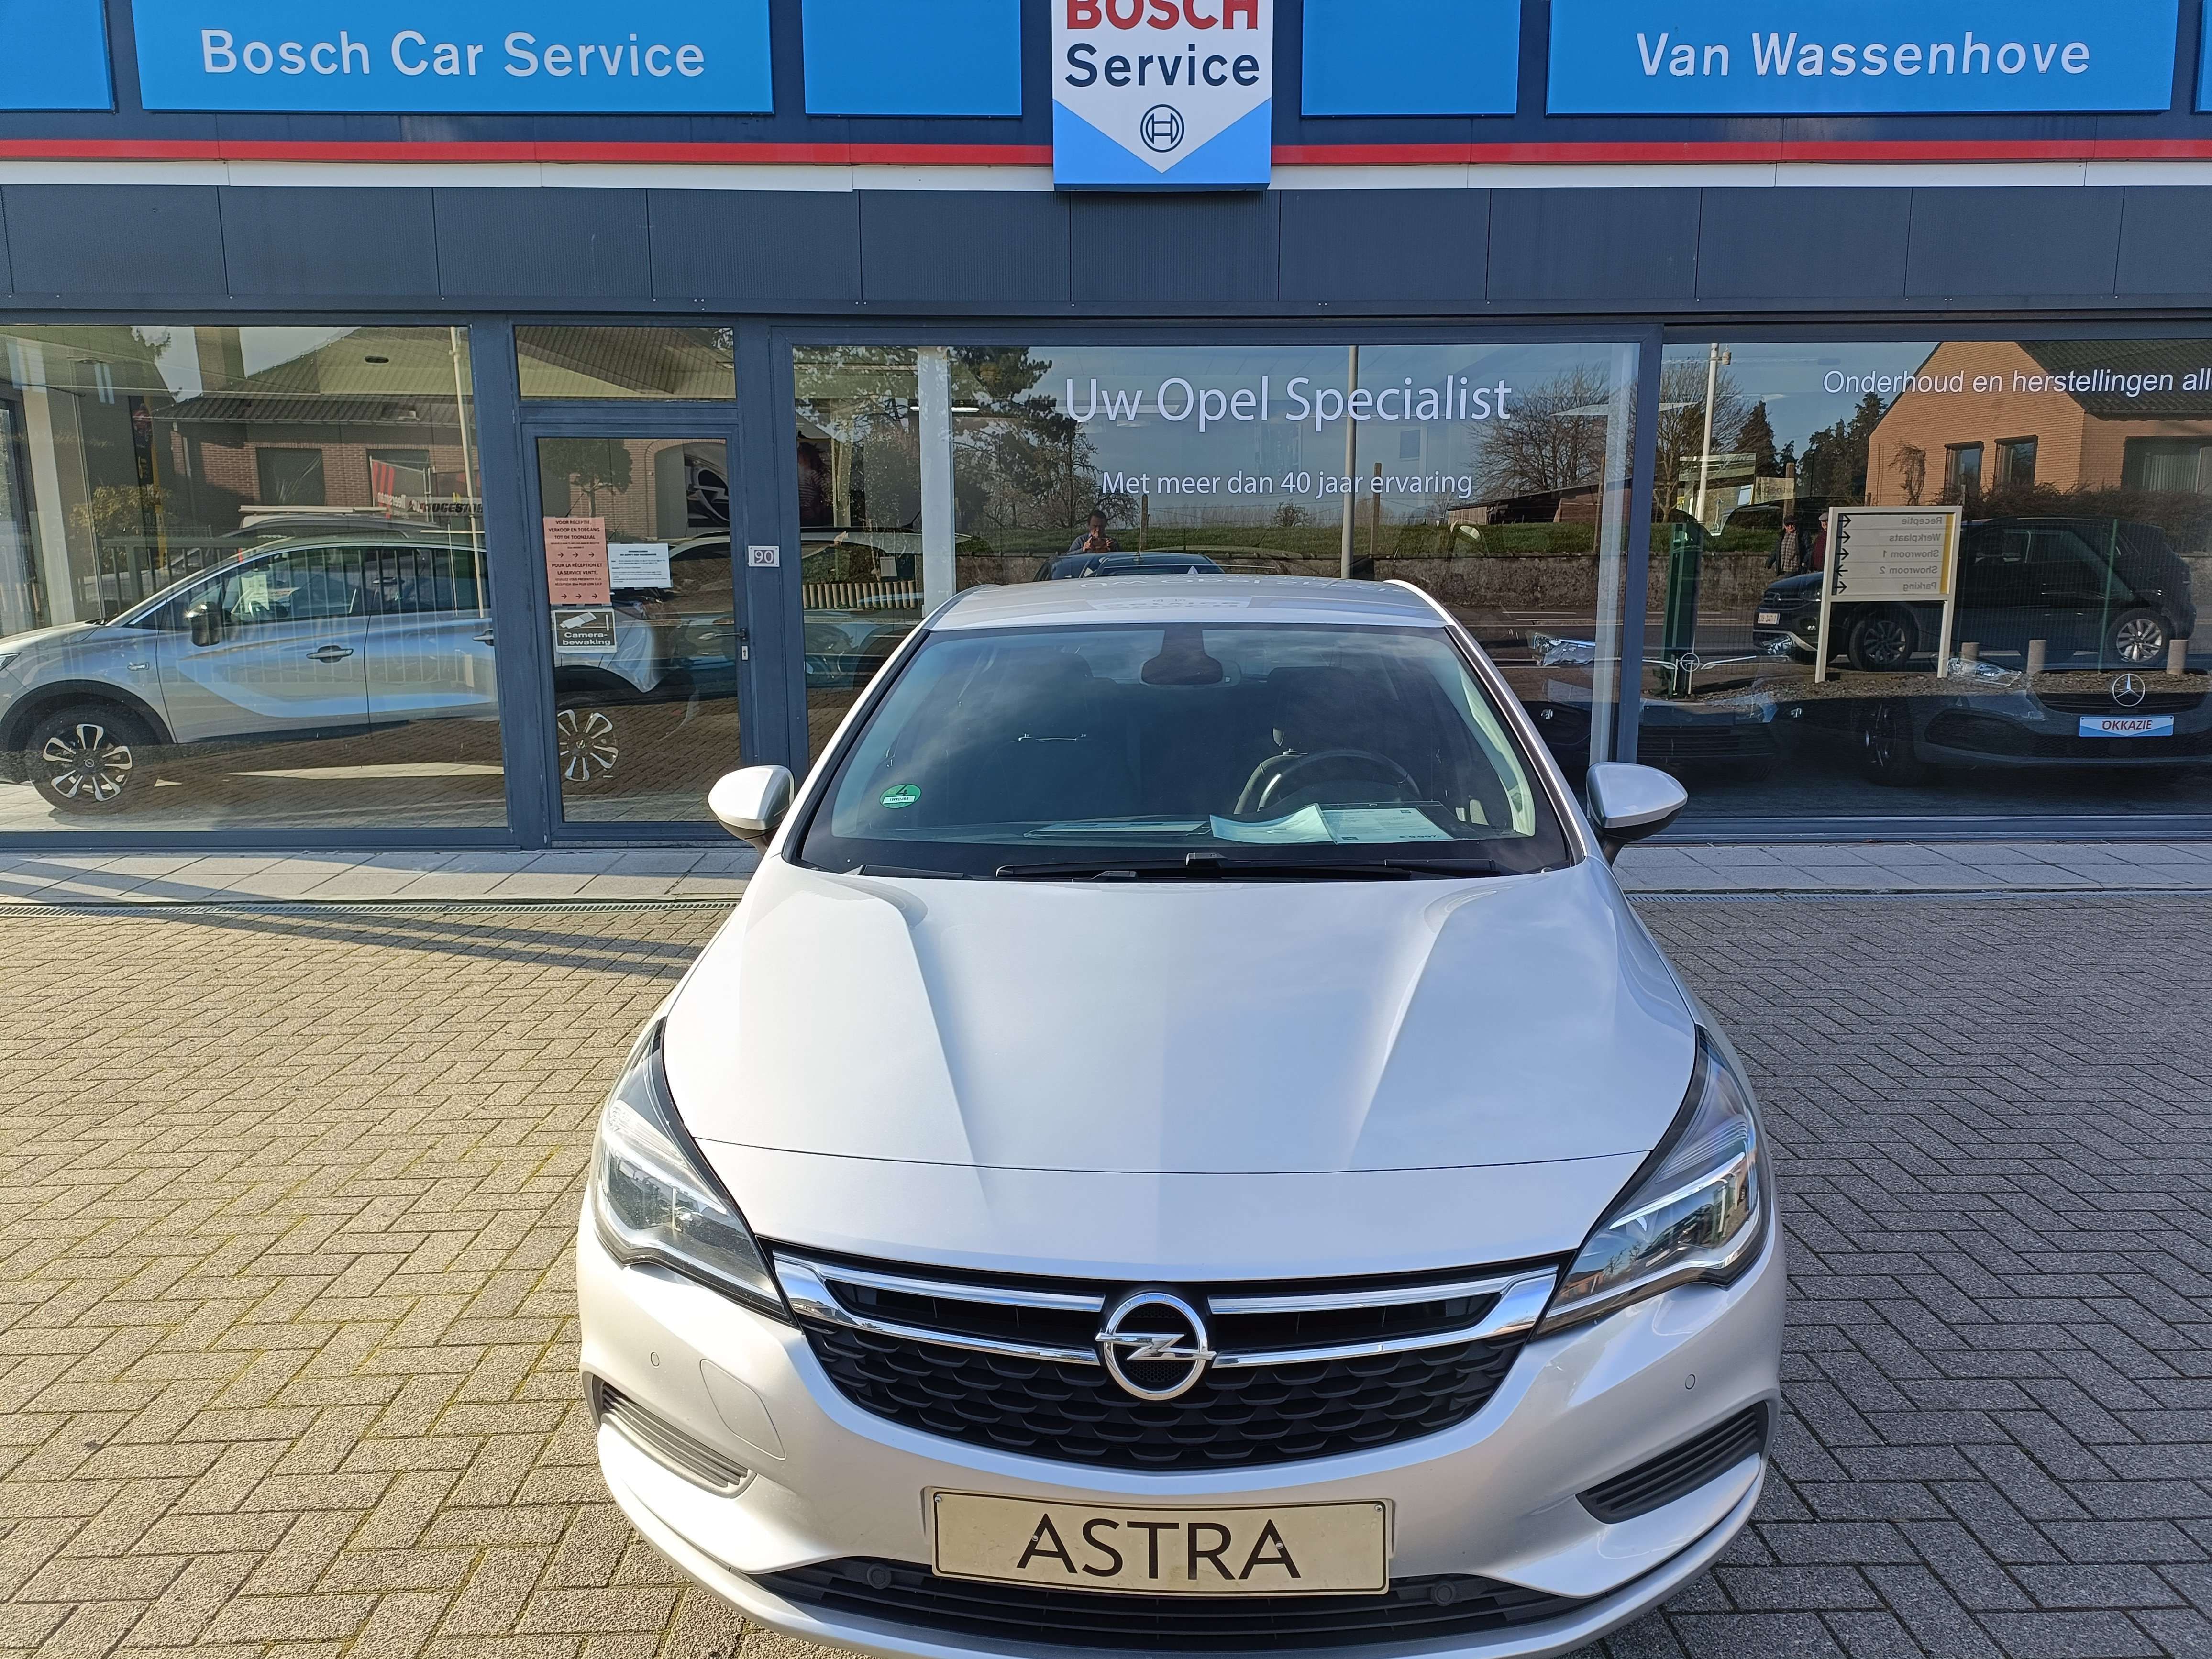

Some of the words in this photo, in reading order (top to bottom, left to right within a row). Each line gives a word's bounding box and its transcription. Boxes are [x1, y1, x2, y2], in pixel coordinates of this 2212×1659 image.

[1067, 0, 1258, 30] BOSCH
[201, 29, 371, 76] Bosch
[390, 30, 484, 77] Car
[503, 32, 705, 78] Service
[1065, 43, 1260, 88] Service
[1636, 33, 1730, 77] Van
[1750, 31, 2090, 77] Wassenhove
[1822, 369, 1964, 394] Onderhoud
[1971, 374, 2003, 393] en
[2011, 368, 2174, 398] herstellingen
[2182, 368, 2212, 391] all
[1065, 377, 1143, 422] Uw
[1157, 376, 1269, 432] Opel
[1285, 375, 1512, 432] Specialist
[1102, 471, 1150, 496] Met
[1157, 476, 1222, 495] meer
[1226, 471, 1273, 495] dan
[1280, 472, 1312, 495] 40
[1314, 472, 1364, 499] jaar
[1369, 471, 1473, 499] ervaring
[754, 550, 774, 564] 90
[2102, 719, 2153, 730] OKKAZIE
[896, 785, 908, 796] 4
[1124, 1294, 1188, 1312] OPEL
[1015, 1512, 1302, 1581] ASTRA
